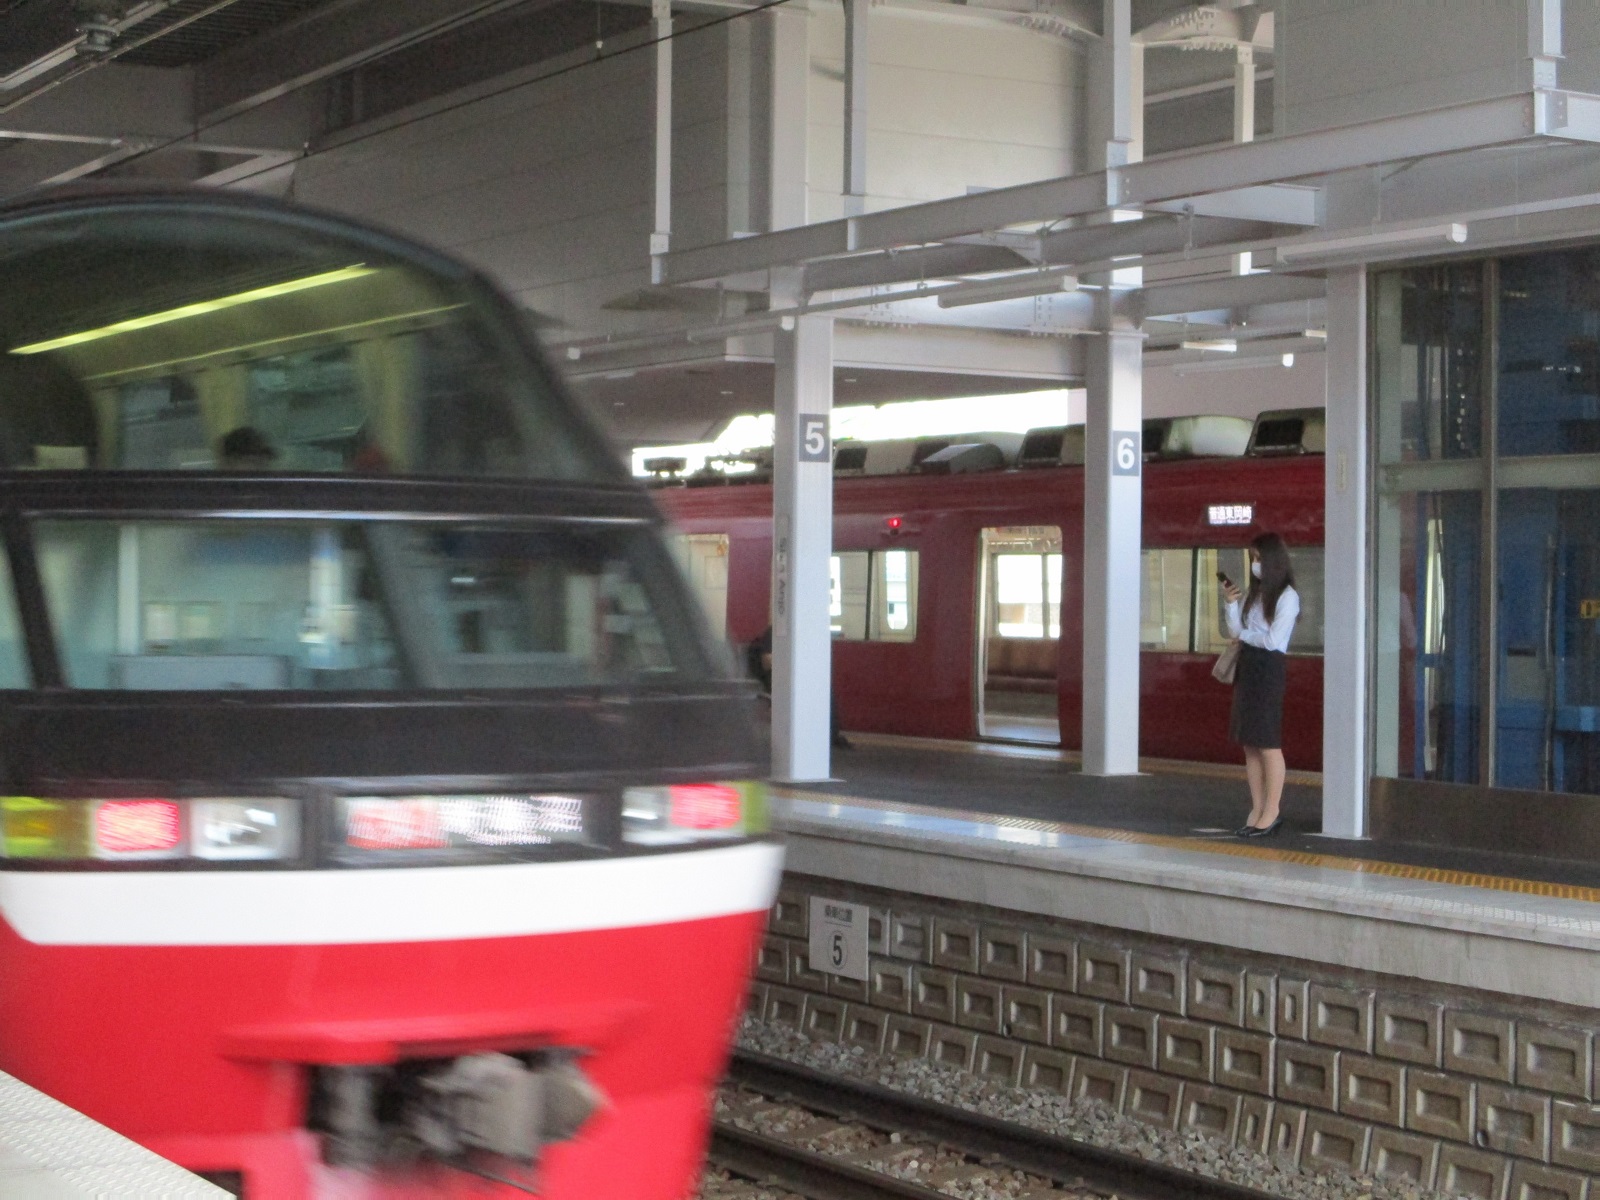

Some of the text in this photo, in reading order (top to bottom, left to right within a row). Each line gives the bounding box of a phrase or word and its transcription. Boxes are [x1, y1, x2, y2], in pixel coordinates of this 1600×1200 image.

[804, 421, 825, 455] 5
[1117, 437, 1135, 470] 6
[832, 934, 842, 966] 5
